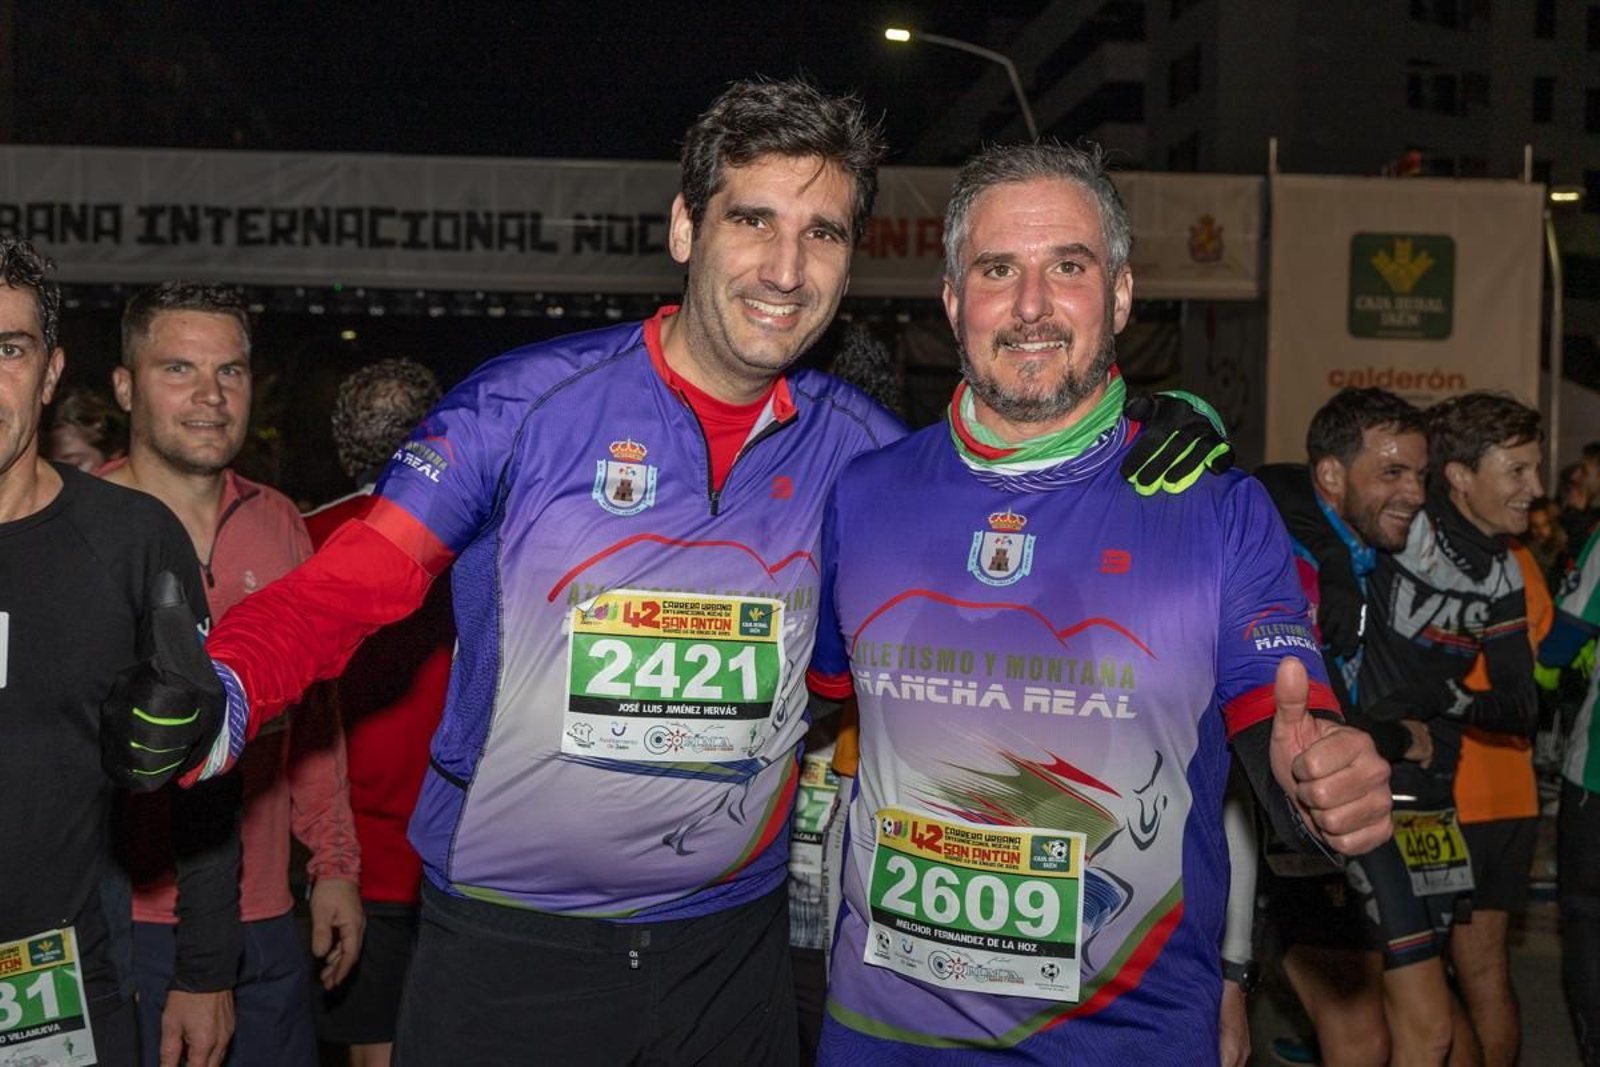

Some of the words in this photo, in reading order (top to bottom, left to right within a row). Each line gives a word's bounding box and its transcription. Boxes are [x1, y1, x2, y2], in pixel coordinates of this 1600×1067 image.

[136, 205, 558, 252] INTERNACIONAL
[403, 452, 440, 483] REAL
[622, 600, 661, 630] 42
[662, 600, 700, 610] CARRERA
[701, 602, 732, 611] URBANA
[661, 616, 688, 629] SAN
[690, 617, 732, 631] ANTON
[585, 639, 758, 700] 2421
[855, 640, 974, 675] ATLETISMO
[984, 654, 998, 676] Y
[1006, 655, 1136, 690] MONTAÑA
[618, 703, 640, 713] JOSÉ
[642, 704, 663, 714] LUIS
[665, 703, 701, 715] JIMÉNEZ
[703, 704, 738, 716] HERVÁS
[855, 671, 1011, 711] MANCHA
[1023, 686, 1138, 720] REAL
[911, 821, 943, 854] 42
[945, 826, 983, 841] CARRERA
[985, 834, 1021, 845] URBANA
[943, 843, 969, 858] SAN
[972, 847, 1021, 865] ANTON
[880, 855, 1060, 939] 2609
[896, 918, 932, 937] MELCHOR
[934, 929, 985, 947] FERNANDEZ
[987, 937, 999, 948] DE
[1002, 939, 1015, 950] LA
[1017, 941, 1038, 953] HOZ
[8, 1023, 61, 1042] VILLANUEVA
